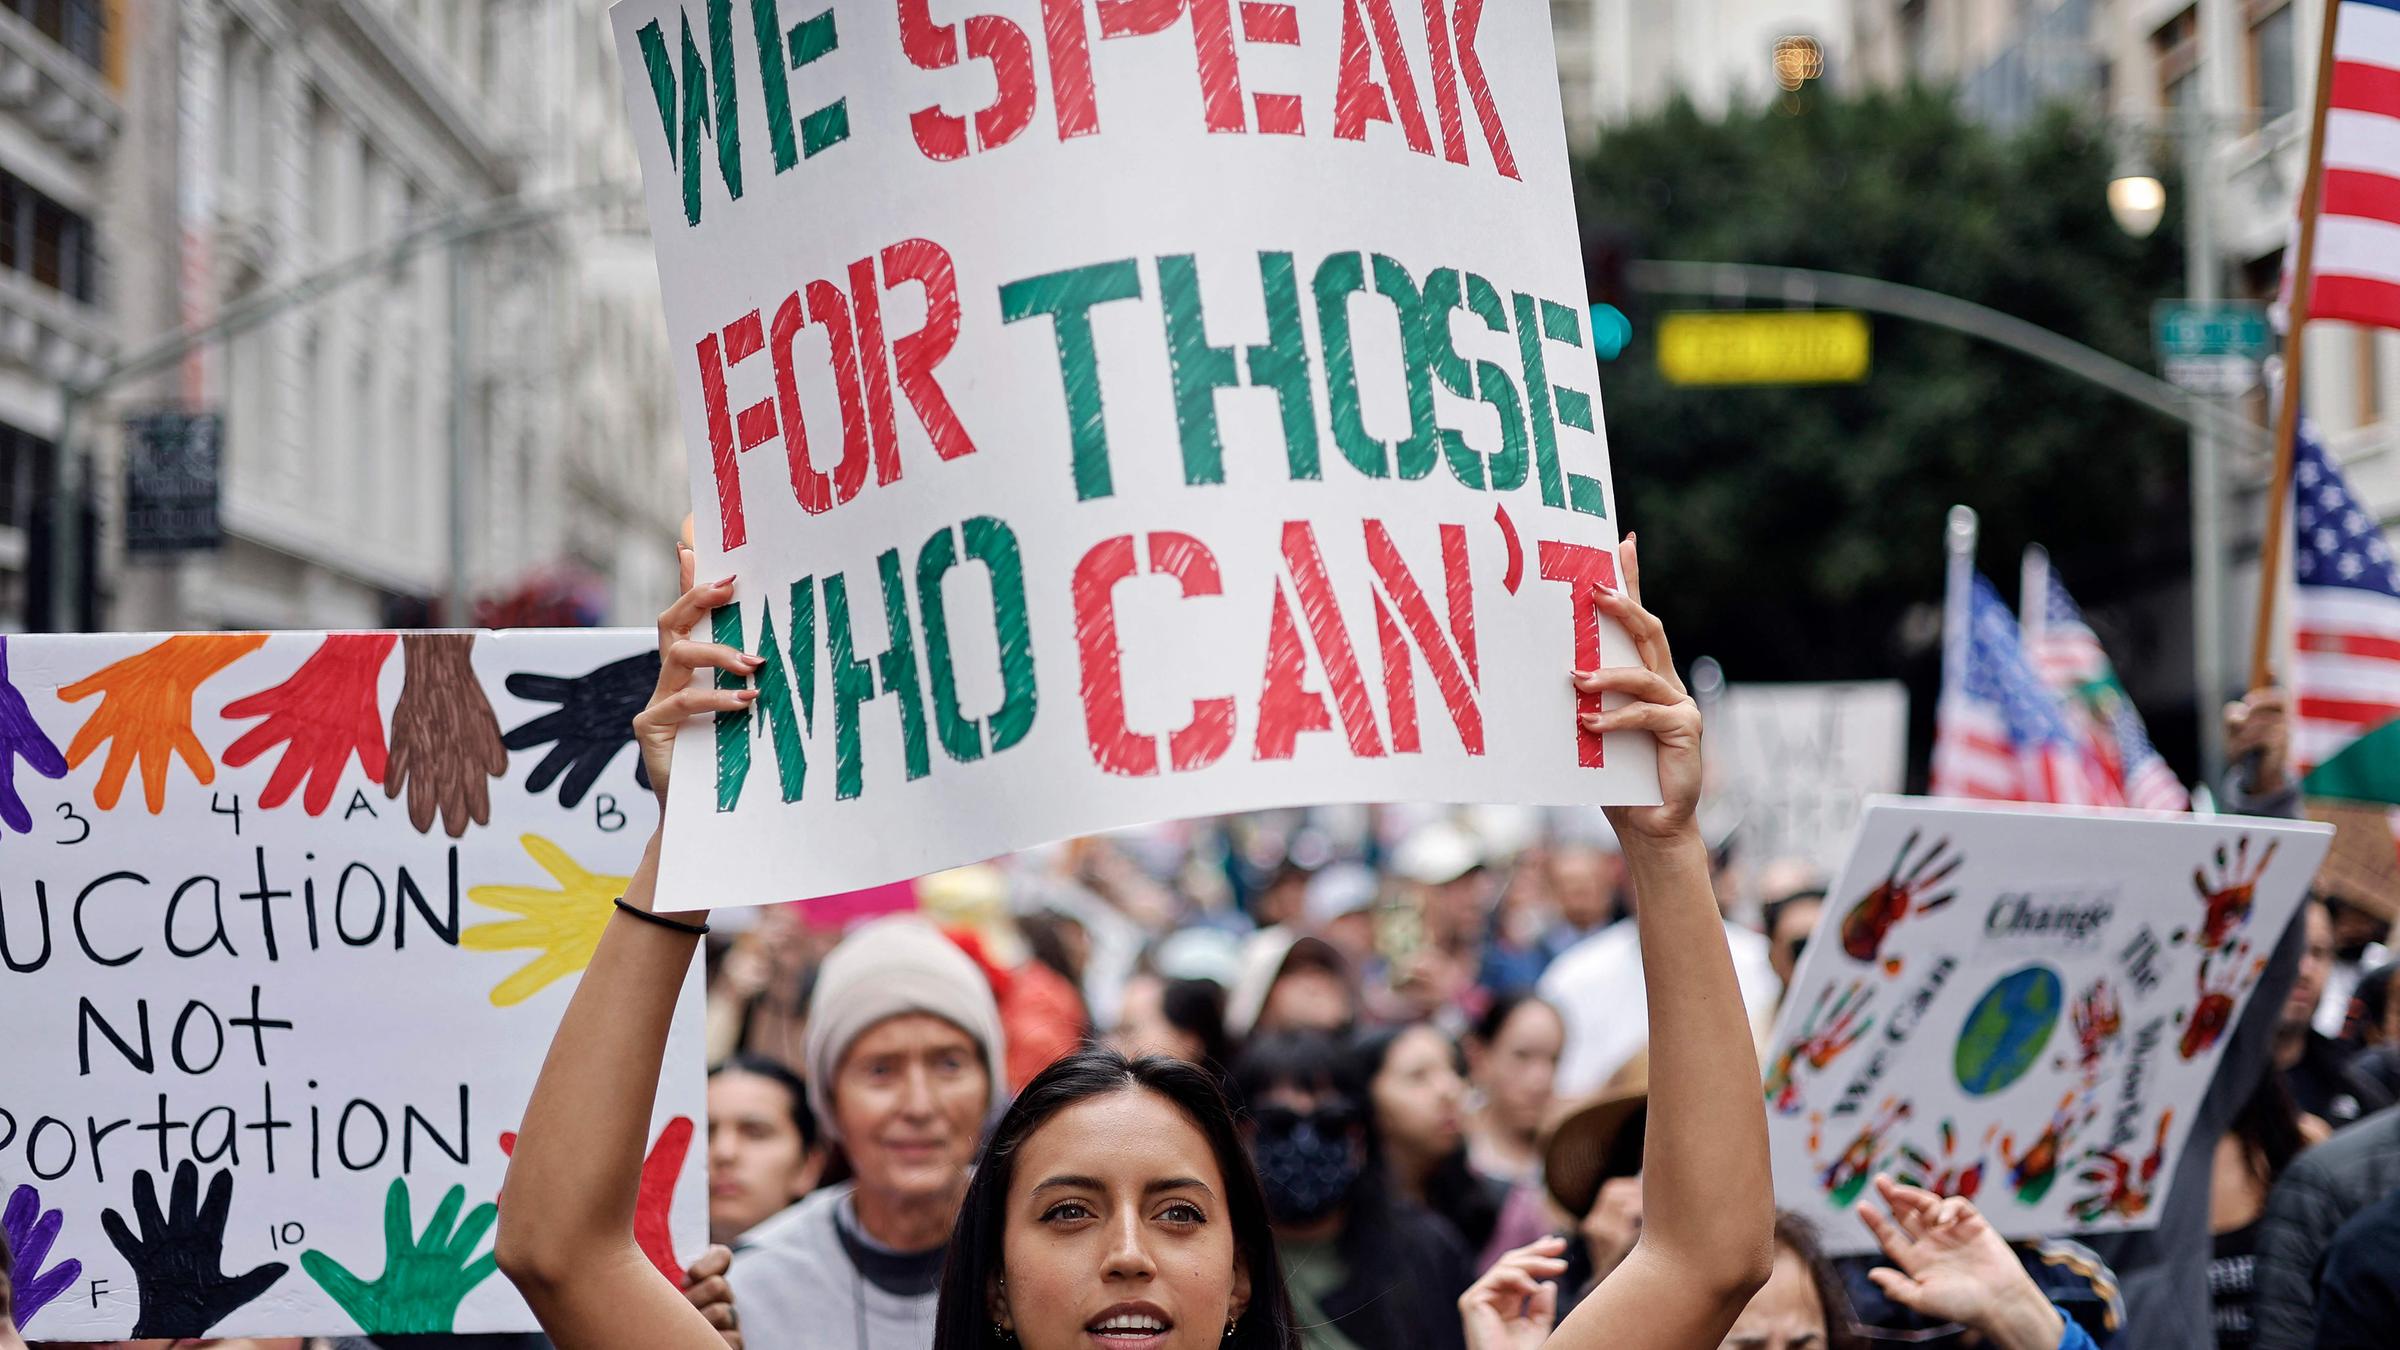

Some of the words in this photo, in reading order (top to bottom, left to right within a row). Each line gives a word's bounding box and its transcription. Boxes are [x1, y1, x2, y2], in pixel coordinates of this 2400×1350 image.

[637, 0, 850, 228] WE
[895, 0, 1523, 182] SPEAK
[697, 238, 977, 551] FOR
[999, 250, 1608, 520] THOSE
[712, 515, 1038, 813] WHO
[1073, 502, 1618, 777] CAN'T
[56, 802, 91, 845] 3
[211, 792, 241, 835] 4
[343, 789, 378, 820] A
[596, 796, 627, 832] B
[1983, 893, 2115, 942] Change
[91, 1279, 110, 1309] F
